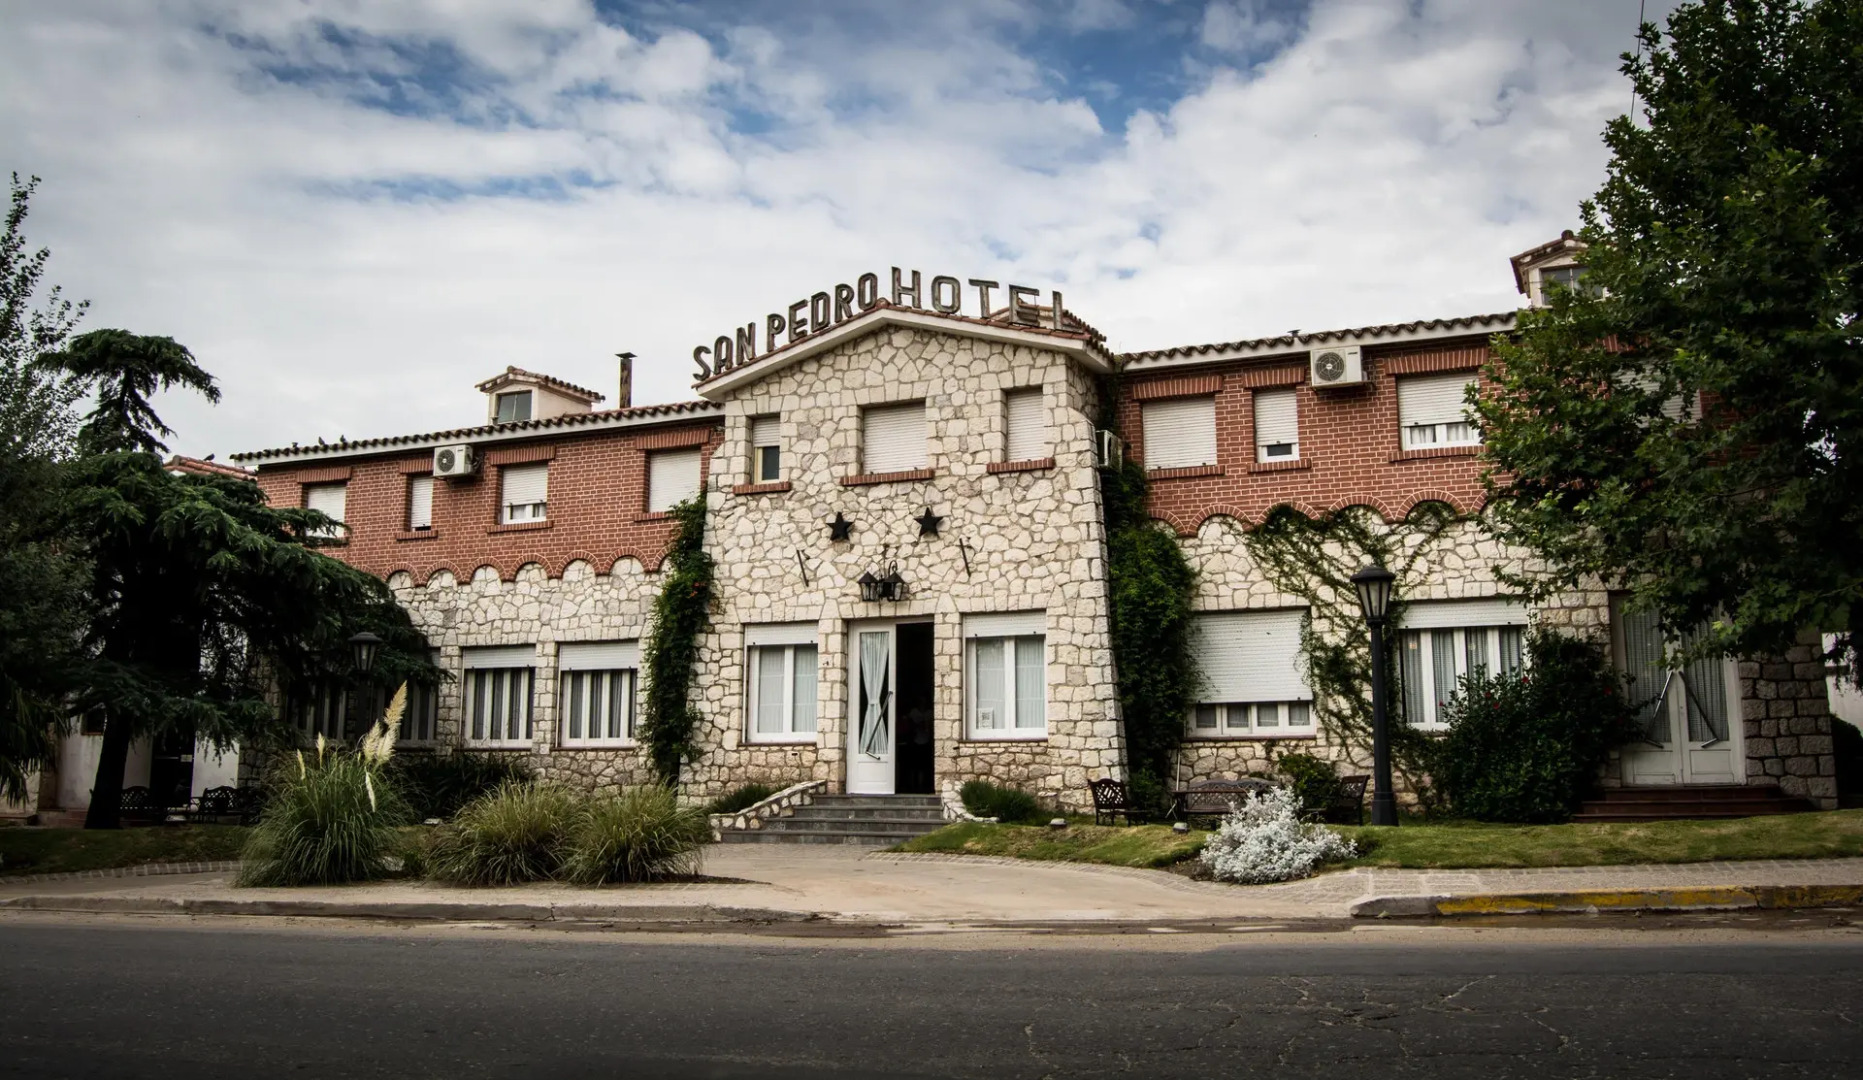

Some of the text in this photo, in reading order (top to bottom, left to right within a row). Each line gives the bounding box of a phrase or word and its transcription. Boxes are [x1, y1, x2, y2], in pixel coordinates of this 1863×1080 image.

[692, 266, 1084, 380] SAN PEDRO HOTEL
